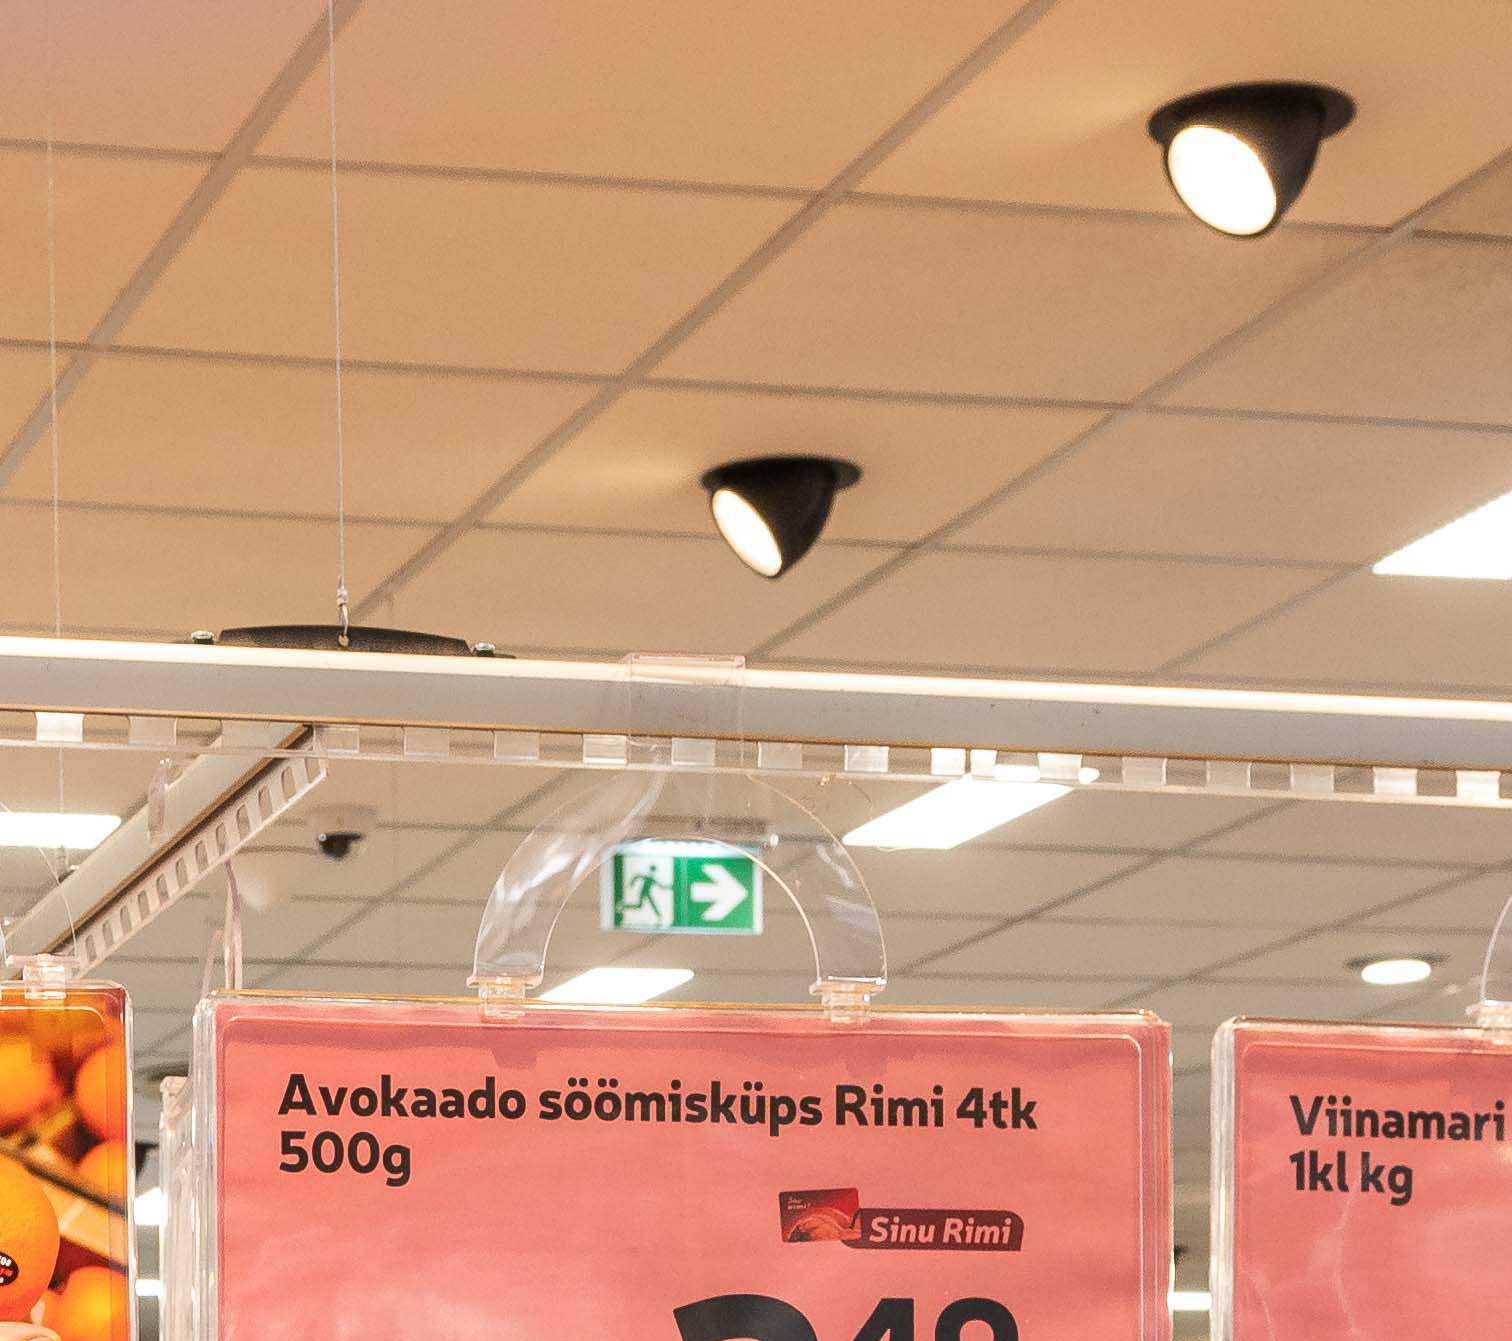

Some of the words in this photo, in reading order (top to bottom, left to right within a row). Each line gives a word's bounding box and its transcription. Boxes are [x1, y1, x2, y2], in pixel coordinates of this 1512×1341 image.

[277, 1073, 527, 1120] Avokaado
[538, 1077, 823, 1137] söömisküps
[835, 1083, 944, 1128] Rimi
[956, 1087, 1038, 1130] 4tk
[1289, 1094, 1505, 1142] Viinamari
[279, 1130, 411, 1187] 500g
[1289, 1149, 1350, 1193] 1kl
[1360, 1151, 1413, 1207] kg
[868, 1215, 936, 1244] Sinu
[942, 1217, 1012, 1244] Rimi
